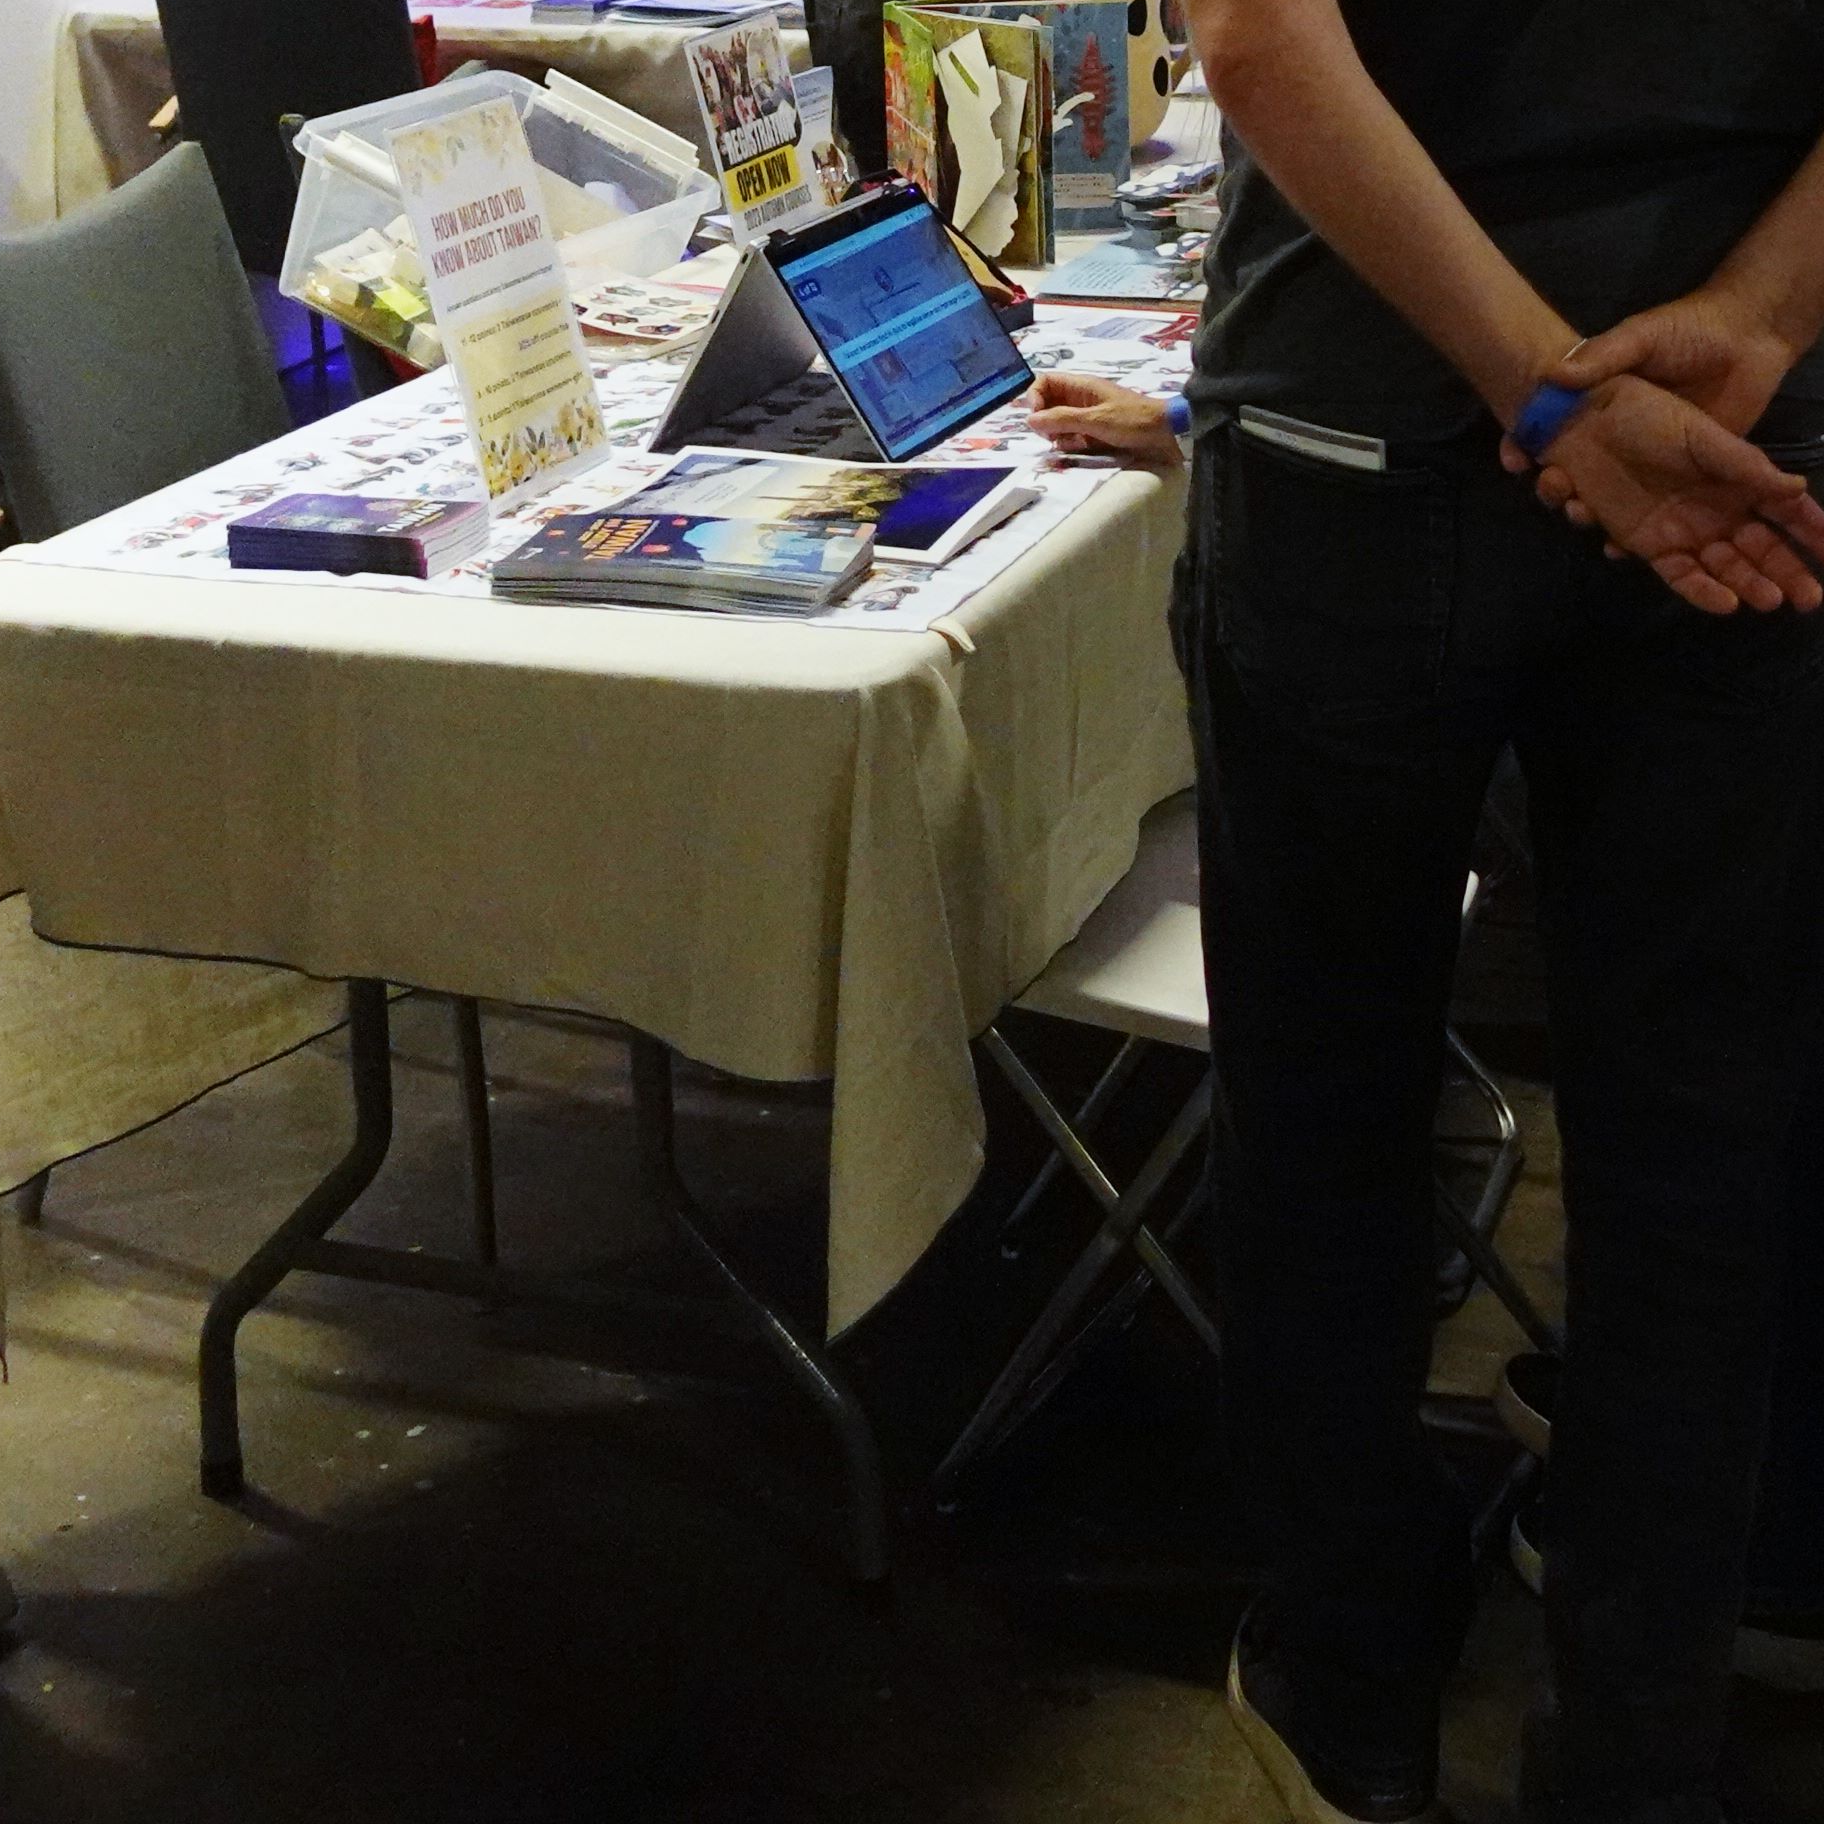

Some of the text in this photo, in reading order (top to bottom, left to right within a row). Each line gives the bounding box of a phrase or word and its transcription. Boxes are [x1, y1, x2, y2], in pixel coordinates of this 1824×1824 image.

[721, 110, 798, 166] REGISTRATION
[736, 151, 792, 204] OPEN NOW
[431, 186, 527, 243] HOW MUCH DO YOU
[431, 213, 545, 279] KNOW ABOUT TAIWAN?
[376, 503, 448, 533] TAIWAN
